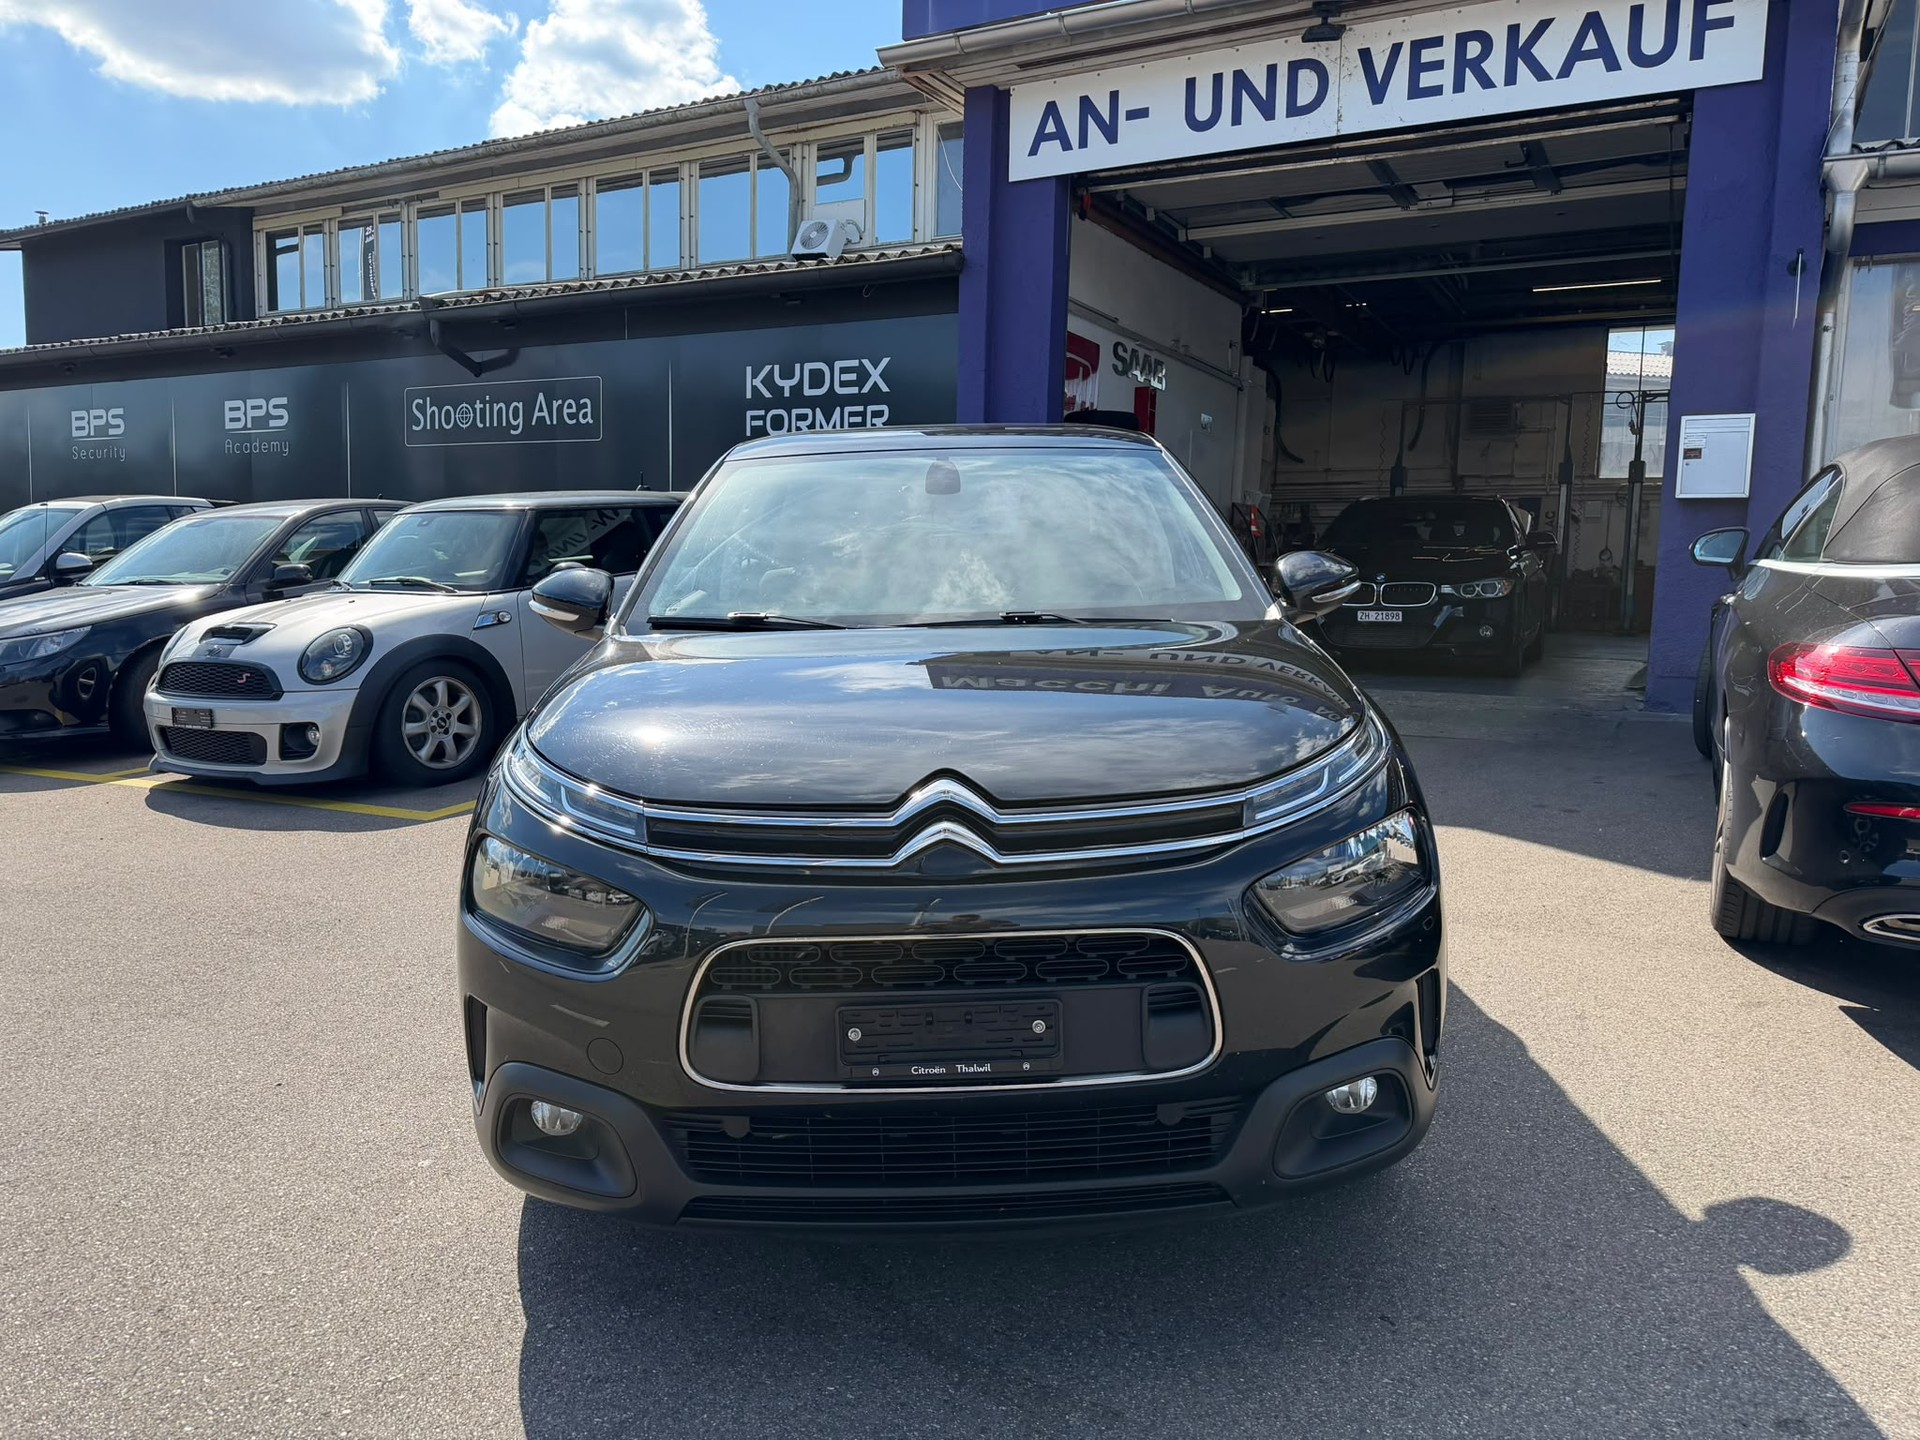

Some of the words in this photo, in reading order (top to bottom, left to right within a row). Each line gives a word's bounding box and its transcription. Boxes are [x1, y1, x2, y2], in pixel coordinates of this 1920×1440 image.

[1027, 89, 1150, 157] AN-
[1184, 57, 1330, 133] UND
[1357, 0, 1735, 106] VERKAUF
[745, 356, 892, 400] KYDEX
[1111, 341, 1167, 391] SAAB
[70, 407, 125, 437] BPS
[223, 397, 290, 429] BPS
[531, 391, 594, 426] Area
[745, 404, 890, 437] FORMER
[71, 446, 126, 462] Security
[224, 438, 290, 456] Academy
[911, 1066, 946, 1075] Citroën
[955, 1063, 992, 1074] Thalwil
